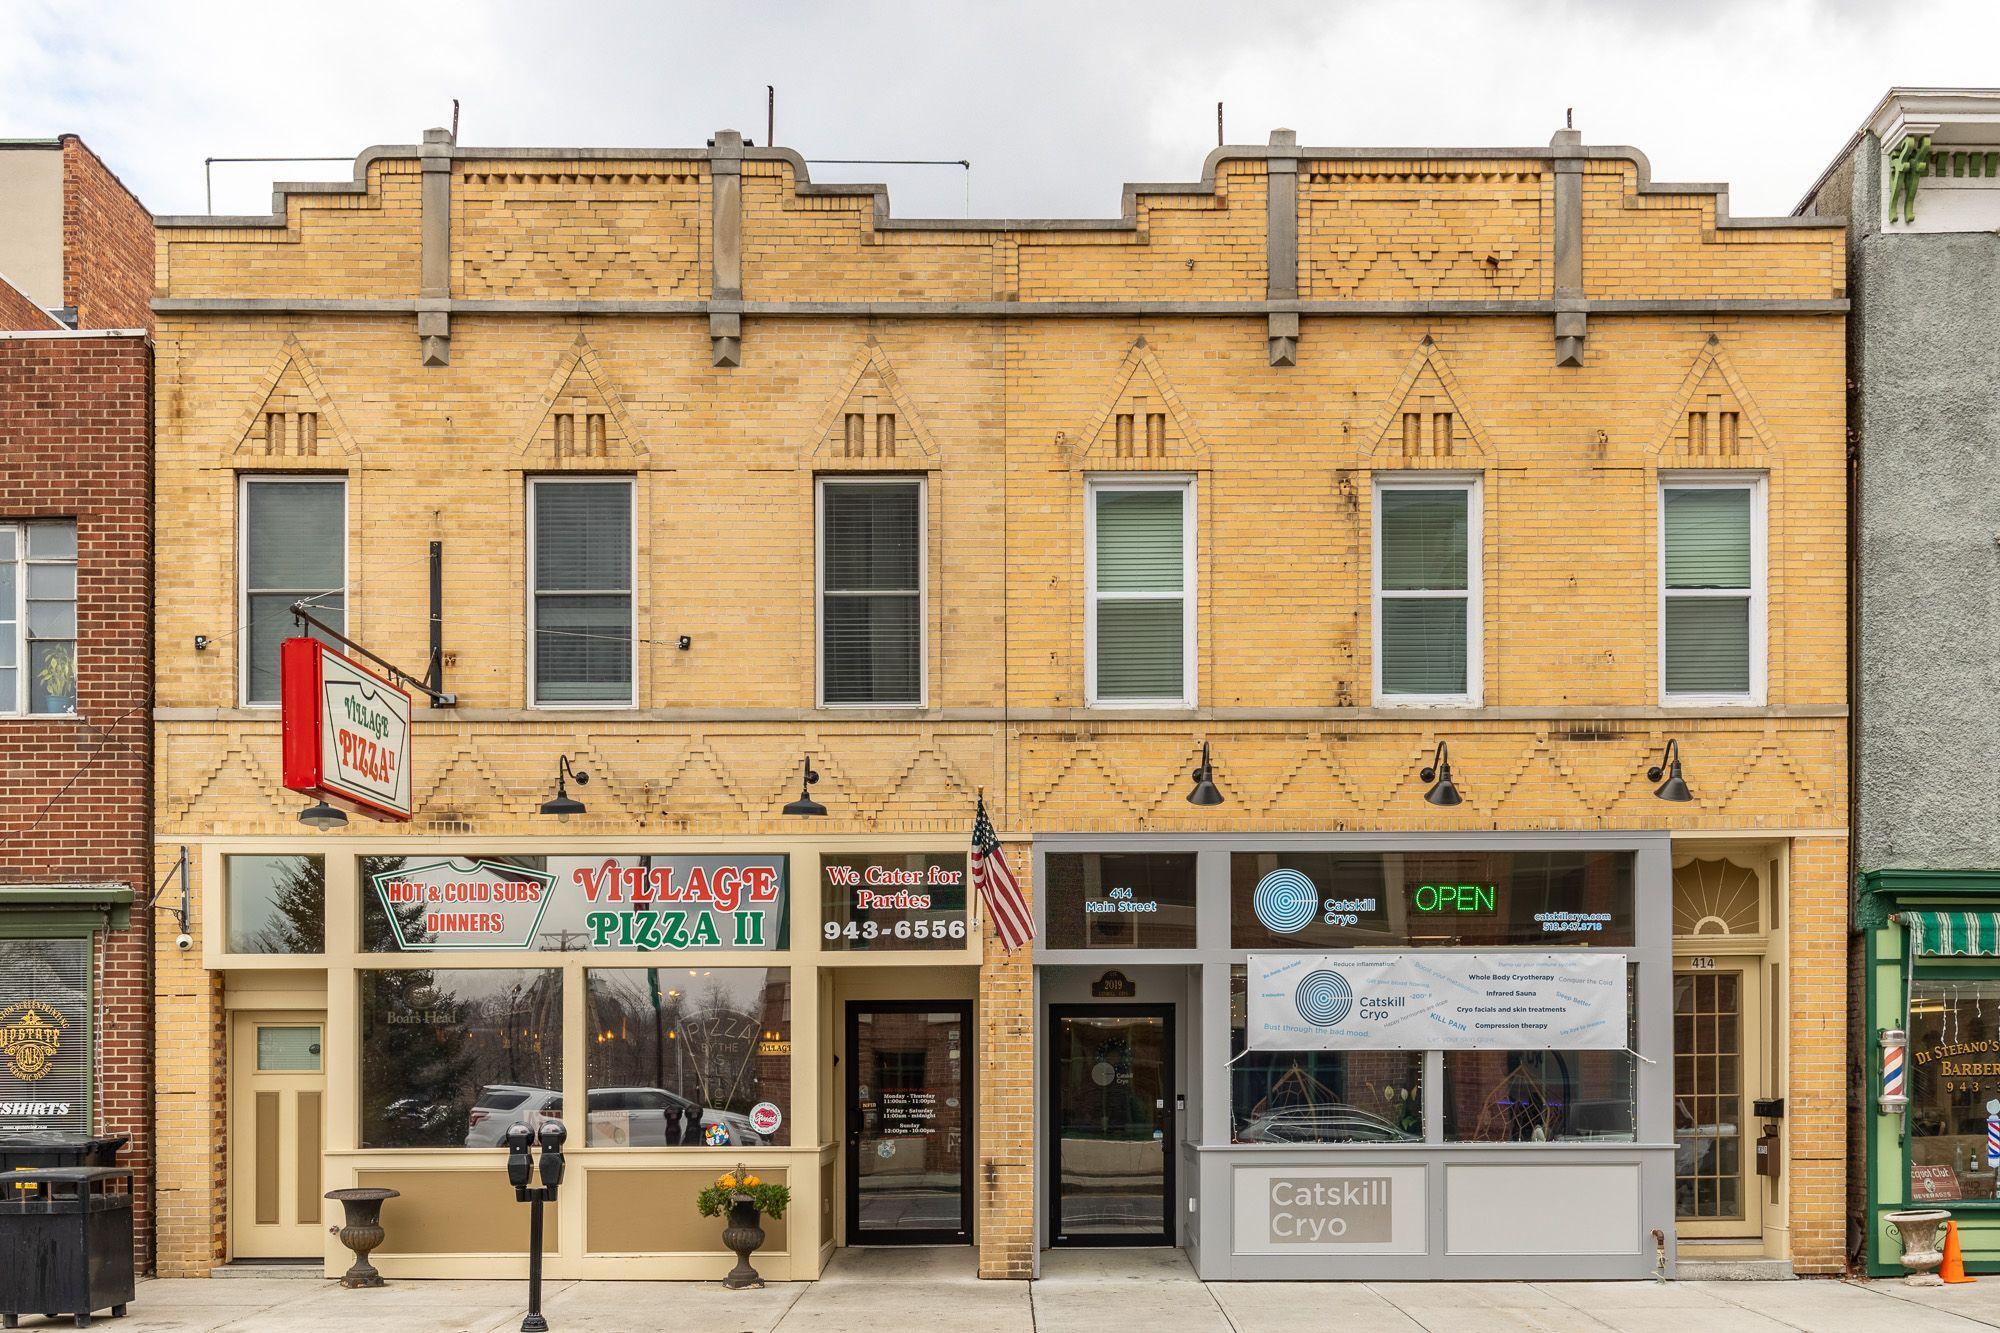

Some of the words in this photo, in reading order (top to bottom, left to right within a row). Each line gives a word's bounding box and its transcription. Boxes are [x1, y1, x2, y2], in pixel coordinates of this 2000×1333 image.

[344, 694, 389, 740] VILLAGE
[339, 728, 389, 784] PIZZA
[826, 866, 860, 885] We
[864, 866, 923, 885] Cater
[928, 865, 962, 885] for
[388, 882, 426, 903] HOT
[428, 884, 443, 903] &
[444, 882, 491, 903] COLD
[492, 882, 542, 903] SUBS
[572, 858, 779, 912] VILLAGE
[1110, 887, 1132, 899] 414
[857, 889, 931, 909] Parties
[1085, 901, 1115, 912] Main
[1118, 901, 1157, 912] Street
[1324, 898, 1376, 911] Catskill
[1416, 886, 1494, 911] OPEN
[426, 913, 504, 933] DINNERS
[1324, 912, 1358, 926] Cryo
[1534, 912, 1611, 921] catskillcryo.com
[585, 911, 722, 950] PIZZA
[732, 911, 766, 947] II
[824, 920, 965, 939] 943-6556
[1692, 957, 1715, 969] 414
[1586, 977, 1597, 985] the
[1360, 997, 1405, 1007] Catskill
[424, 1010, 457, 1024] Head
[1360, 1009, 1389, 1021] Cryo
[1430, 1012, 1446, 1024] KILL
[1447, 1018, 1467, 1032] PAIN
[686, 1017, 752, 1045] PIZZA
[1263, 1023, 1281, 1031] Bust
[1282, 1025, 1313, 1034] through
[1315, 1026, 1328, 1034] the
[1329, 1028, 1345, 1036] bad
[701, 1042, 714, 1053] BY
[717, 1042, 739, 1053] THE
[1915, 1051, 1932, 1065] DI
[1934, 1040, 2000, 1059] STEFANO'S
[0, 1102, 70, 1115] SHIRTS
[1272, 1181, 1387, 1206] Catskill
[1272, 1212, 1347, 1241] Cryo
